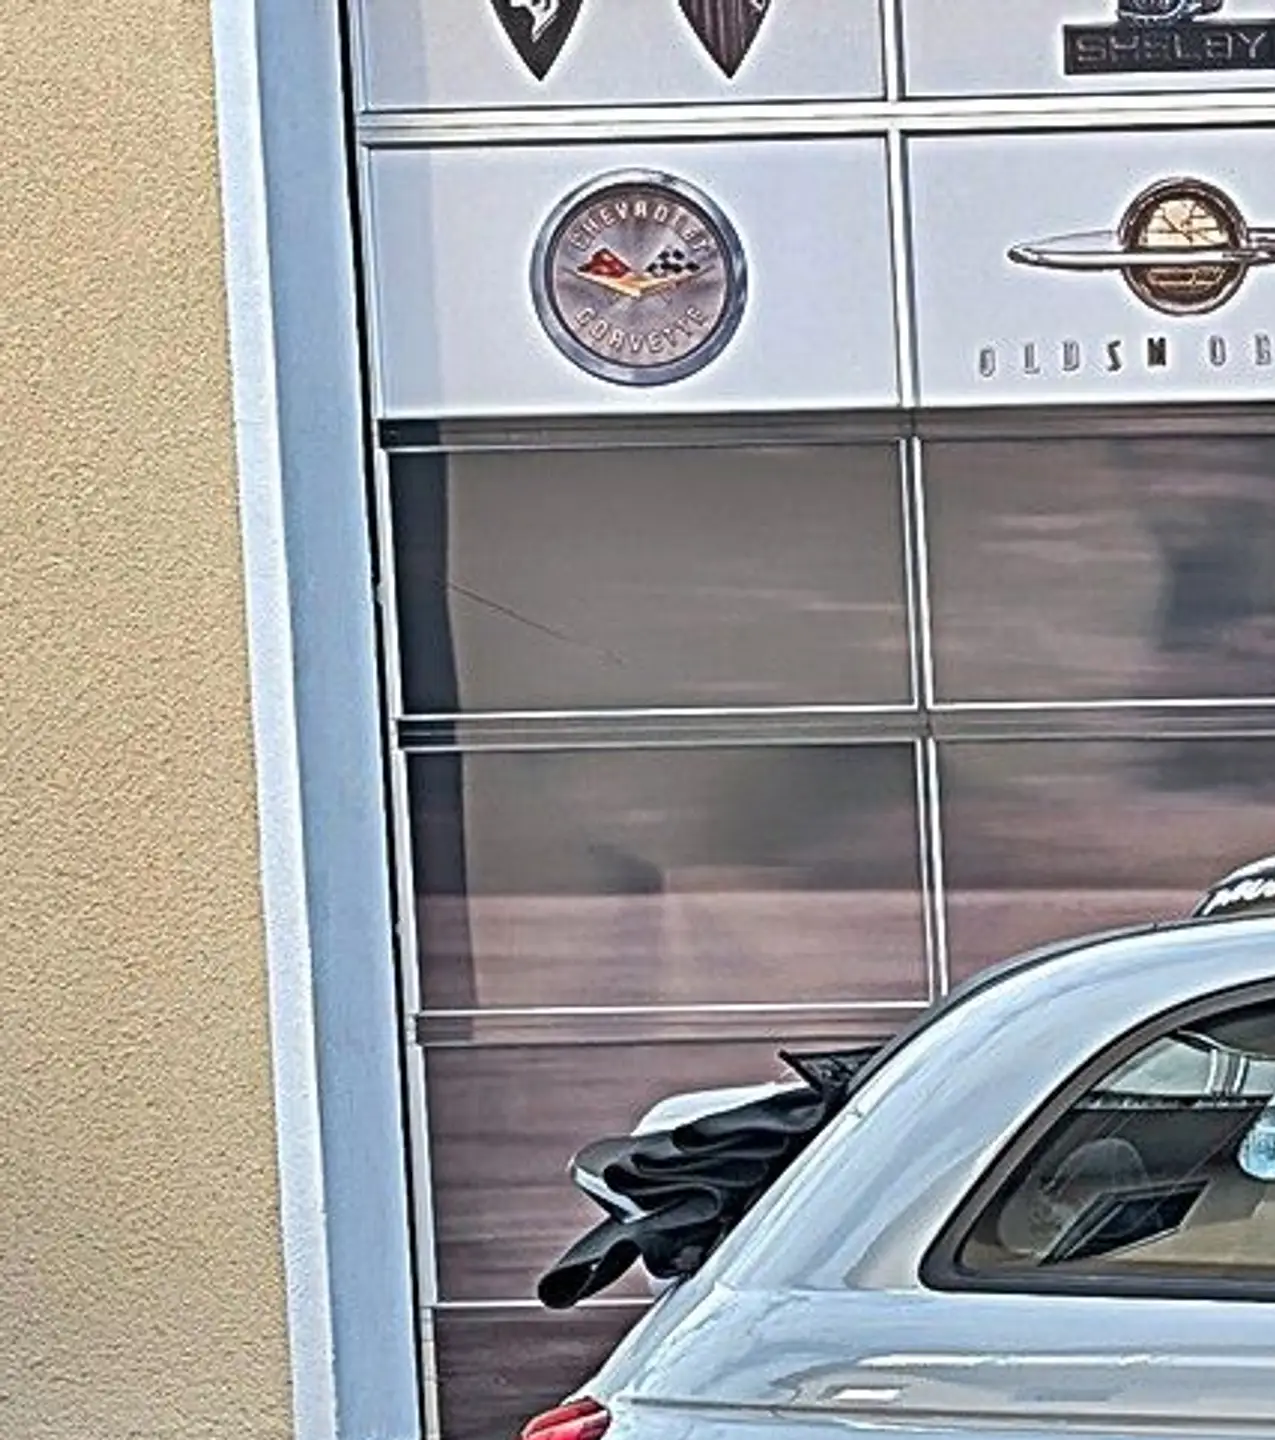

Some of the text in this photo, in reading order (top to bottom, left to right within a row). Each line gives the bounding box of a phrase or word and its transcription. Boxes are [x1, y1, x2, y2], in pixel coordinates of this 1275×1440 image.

[1076, 31, 1267, 62] SHELBY
[570, 199, 718, 253] CHEVROLET
[575, 306, 709, 354] CORVETTE
